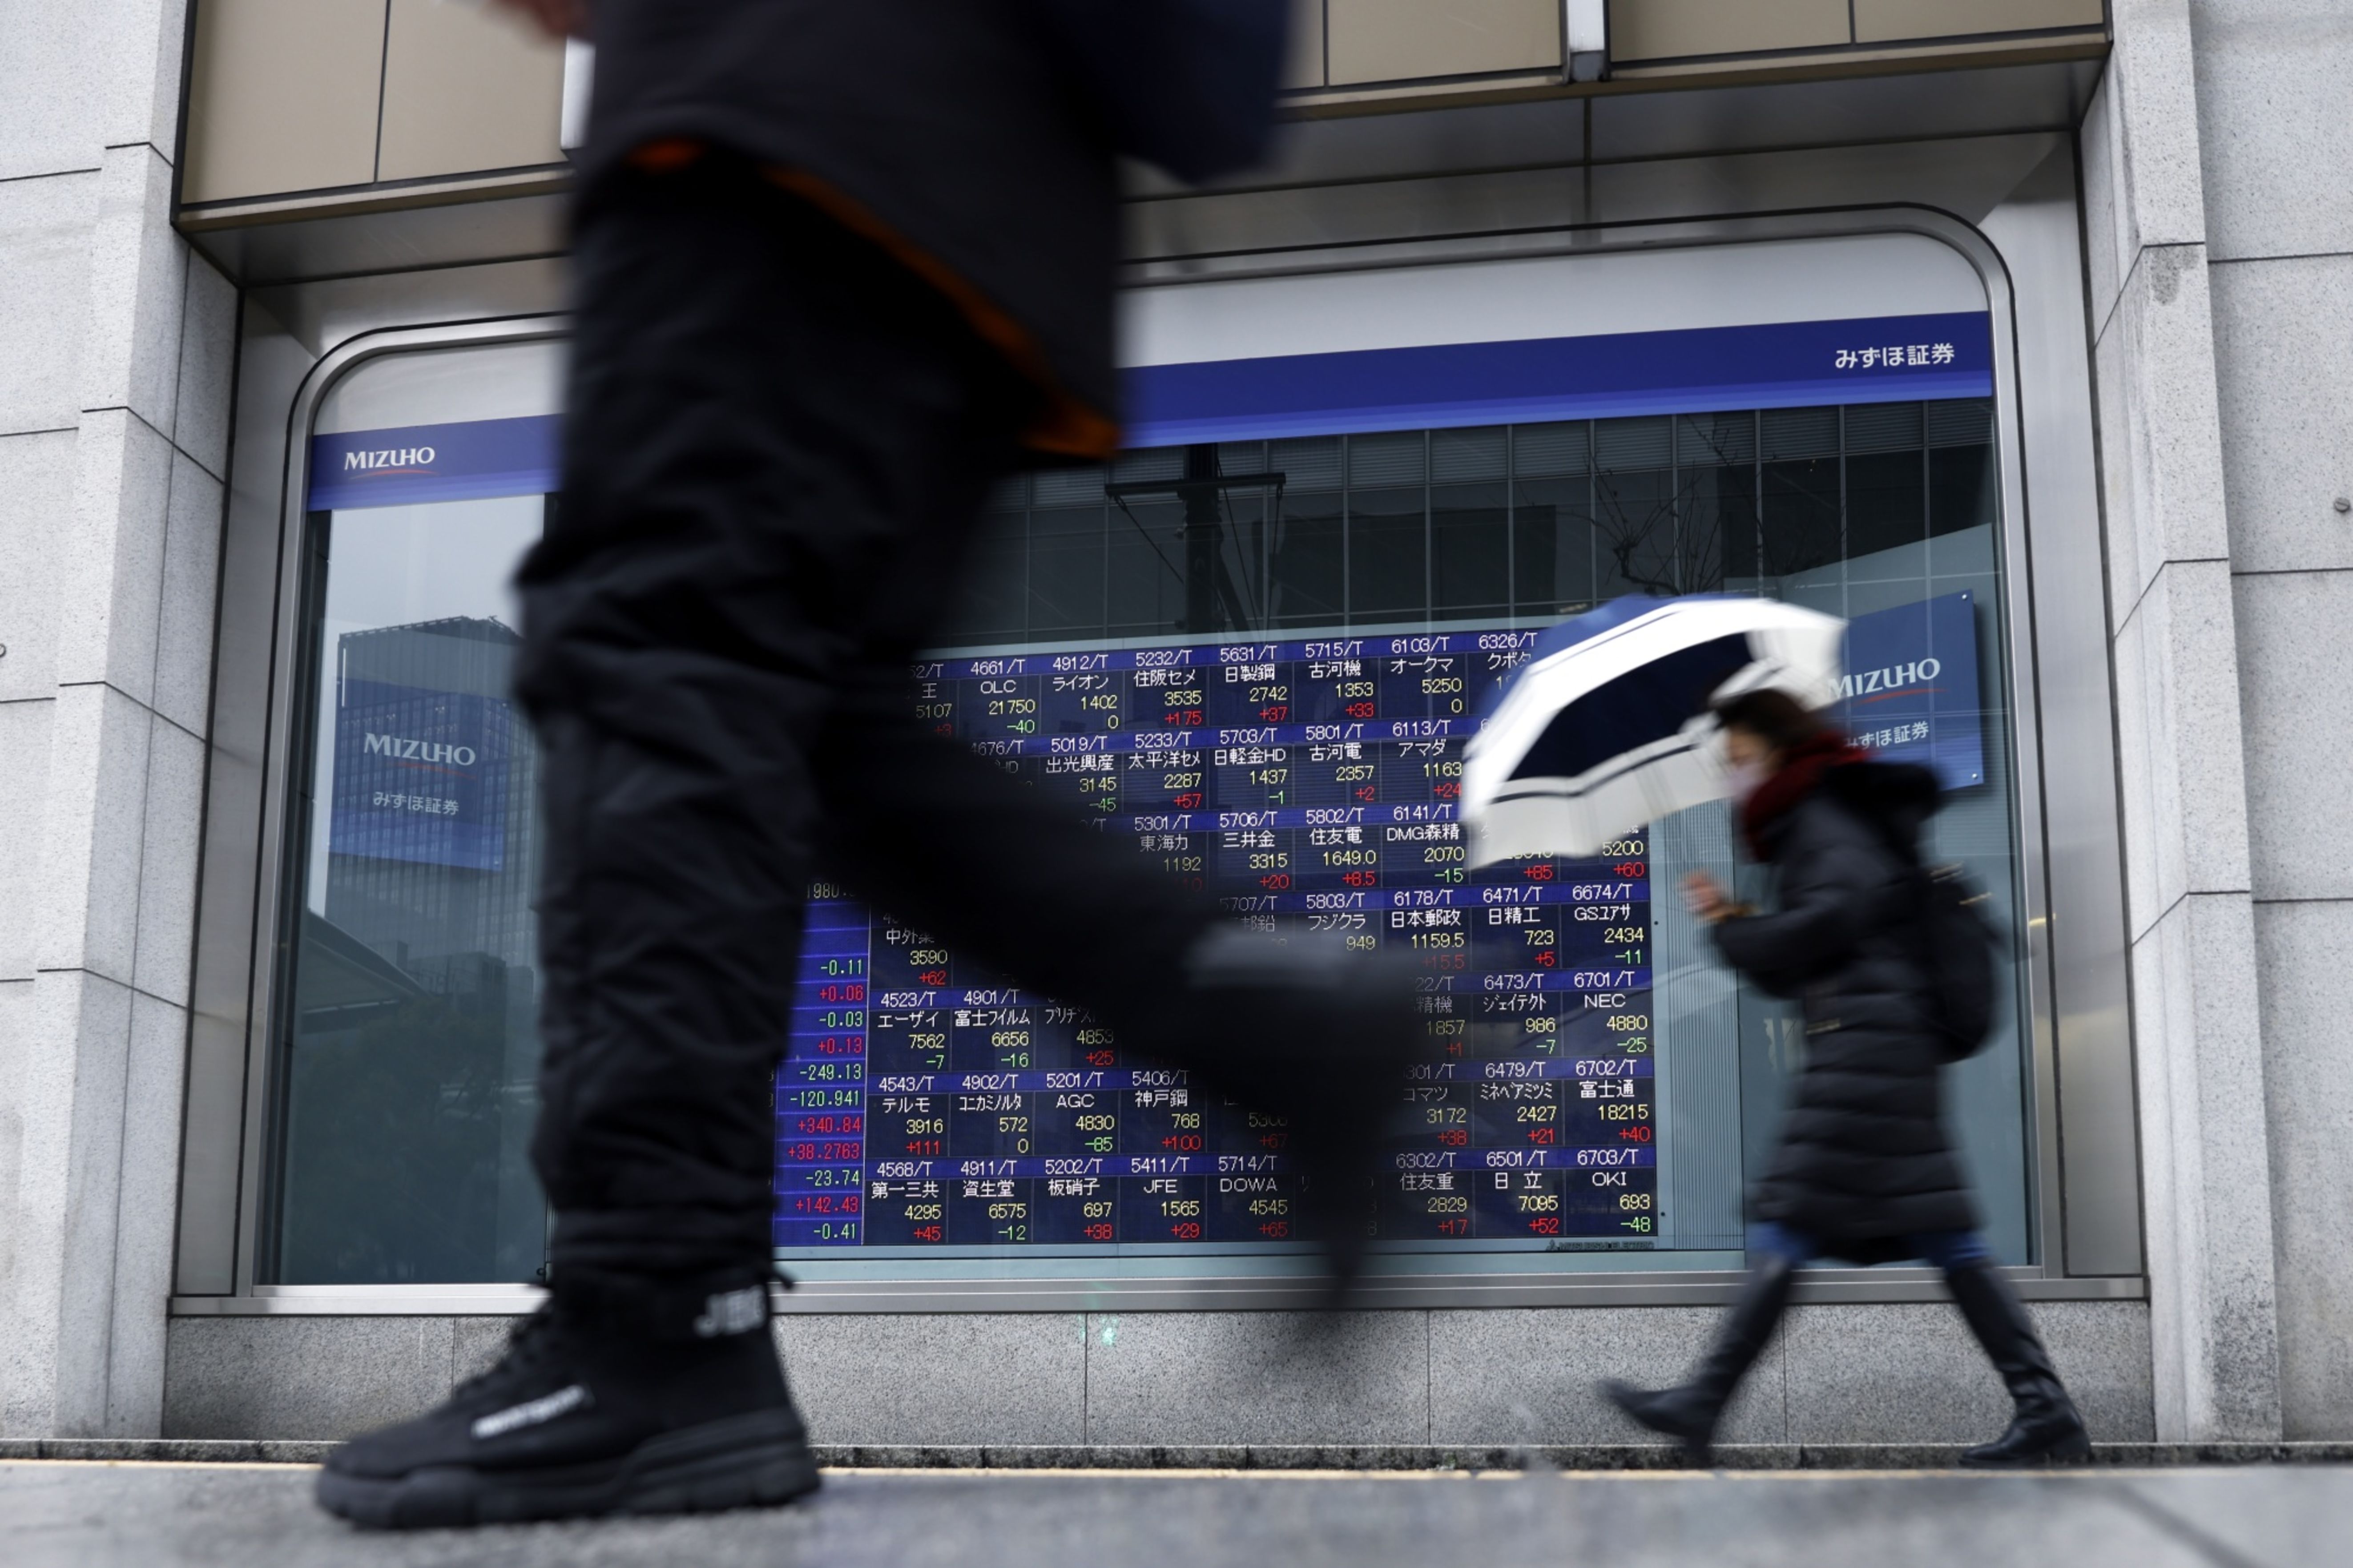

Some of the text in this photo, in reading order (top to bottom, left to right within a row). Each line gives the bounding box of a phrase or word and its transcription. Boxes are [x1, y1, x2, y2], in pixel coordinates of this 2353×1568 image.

[1835, 343, 1954, 368] みずほ証券
[344, 447, 435, 470] MIZUHO
[1391, 635, 1450, 653] 6103/T
[1479, 632, 1537, 649] 6326/T
[1135, 649, 1192, 666] 5232/T
[1221, 645, 1277, 662] 5631/T
[1305, 641, 1363, 658] 5715/T
[970, 658, 1026, 676] 4661/T
[1052, 654, 1108, 671] 4912/T
[1309, 660, 1362, 677] 古河機
[1390, 657, 1454, 674] オークマ
[1134, 668, 1197, 687] 住阪セメ
[1225, 663, 1275, 682] 日製鋼
[1827, 658, 1940, 699] MIZUHO
[980, 680, 1016, 693] OLC
[1052, 675, 1109, 692] ライオン
[1335, 682, 1374, 698] 1353
[1422, 677, 1462, 693] 5250
[1164, 689, 1202, 705] 3535
[1249, 686, 1287, 702] 2742
[989, 699, 1035, 715] 21750
[1081, 695, 1117, 710] 1402
[1346, 702, 1374, 718] +33
[1165, 709, 1202, 726] +175
[1259, 706, 1287, 722] +37
[1220, 728, 1278, 744] 5703/T
[1305, 724, 1364, 740] 5801/T
[1392, 719, 1450, 737] 6113/T
[1051, 735, 1108, 752] 5019/T
[1135, 731, 1193, 748] 5233/T
[363, 733, 476, 766] MIZUHO
[1309, 742, 1362, 760] 古河電
[1398, 740, 1446, 757] アマダ
[1046, 754, 1114, 774] 出光興産
[1214, 748, 1286, 766] 日軽金HD
[1249, 769, 1287, 785] 1437
[1335, 765, 1375, 781] 2357
[1423, 762, 1462, 777] 1163
[1080, 776, 1117, 792] 3145
[1164, 772, 1202, 788] 2287
[373, 791, 459, 815] みずほ証券
[1174, 793, 1202, 808] +57
[1220, 810, 1278, 827] 5706/T
[1306, 807, 1364, 824] 5802/T
[1394, 803, 1452, 821] 6141/T
[1134, 814, 1192, 831] 5301/T
[1223, 830, 1275, 848] 三井金
[1309, 826, 1362, 844] 住友電
[1386, 823, 1459, 842] DMG森精
[1424, 846, 1464, 863] 2070
[1603, 841, 1643, 855] 5200
[1249, 852, 1288, 868] 3315
[1322, 849, 1376, 866] 1649.0
[1434, 868, 1463, 883] -15
[1524, 865, 1553, 880] +85
[1614, 862, 1644, 877] +60
[1259, 874, 1289, 890] +20
[1342, 871, 1375, 887] +8.5
[1394, 888, 1453, 907] 6178/T
[1483, 886, 1543, 903] 6471/T
[1572, 884, 1632, 901] 6674/T
[1306, 892, 1364, 910] 5803/T
[1391, 908, 1462, 928] 日本郵政
[1489, 907, 1540, 924] 日精工
[1574, 903, 1630, 922] GSユアサ
[1308, 912, 1366, 931] フジクラ
[1411, 933, 1464, 949] 1159.5
[1524, 930, 1554, 945] 723
[1604, 927, 1644, 943] 2434
[910, 950, 947, 965] 3590
[1615, 949, 1640, 964] -11
[821, 960, 862, 975] -0.11
[919, 971, 946, 985] +62
[1484, 974, 1544, 989] 6473/T
[1574, 971, 1635, 988] 6701/T
[820, 986, 863, 1001] +0.06
[880, 991, 937, 1008] 4523/T
[964, 989, 1020, 1005] 4901/T
[1584, 994, 1626, 1007] NEC
[1483, 994, 1546, 1012] ジェイテクト
[819, 1012, 863, 1027] -0.03
[878, 1011, 940, 1028] エーザイ
[955, 1009, 1030, 1025] 富士フイルム
[1526, 1018, 1555, 1032] 986
[1607, 1016, 1647, 1031] 4880
[819, 1038, 862, 1053] +0.13
[909, 1034, 945, 1048] 7562
[991, 1032, 1028, 1046] 6656
[1617, 1038, 1646, 1052] -25
[1000, 1053, 1028, 1068] -16
[1576, 1060, 1637, 1075] 6702/T
[800, 1064, 861, 1080] -249.13
[1486, 1063, 1545, 1078] 6479/T
[878, 1076, 935, 1091] 4543/T
[962, 1073, 1019, 1090] 4902/T
[1046, 1072, 1104, 1088] 5201/T
[1480, 1082, 1553, 1100] ミネベアミツミ
[1579, 1081, 1635, 1098] 富士通
[790, 1091, 859, 1107] -120.941
[882, 1097, 930, 1113] テルモ
[960, 1094, 1022, 1111] コニカミノルタ
[1056, 1094, 1095, 1108] AGC
[1135, 1089, 1187, 1107] 神戸鋼
[1517, 1106, 1556, 1121] 2427
[1598, 1105, 1648, 1120] 18215
[798, 1117, 860, 1133] +340.84
[907, 1119, 943, 1133] 3916
[1000, 1118, 1028, 1132] 572
[1076, 1115, 1114, 1130] 4830
[1171, 1113, 1199, 1129] 768
[1162, 1135, 1201, 1150] +100
[1528, 1129, 1554, 1144] +21
[1619, 1127, 1650, 1142] +40
[789, 1144, 860, 1160] +38.2763
[907, 1141, 940, 1155] +111
[1085, 1137, 1112, 1152] -85
[1131, 1157, 1190, 1173] 5411/T
[1396, 1152, 1456, 1168] 6302/T
[1487, 1151, 1547, 1166] 6501/T
[1577, 1149, 1638, 1165] 6703/T
[877, 1161, 933, 1177] 4568/T
[960, 1160, 1017, 1176] 4911/T
[1045, 1158, 1103, 1174] 5202/T
[806, 1171, 860, 1186] -23.74
[1144, 1179, 1178, 1193] JFE
[1400, 1173, 1455, 1191] 住友重
[1592, 1173, 1625, 1185] OKI
[871, 1182, 939, 1199] 第一三共
[963, 1180, 1015, 1197] 資生堂
[1048, 1178, 1100, 1197] 板硝子
[796, 1197, 858, 1213] +142.43
[1084, 1202, 1112, 1217] 697
[1161, 1201, 1199, 1217] 1565
[1519, 1196, 1558, 1211] 7095
[1620, 1195, 1650, 1210] 693
[905, 1205, 941, 1219] 4295
[989, 1204, 1026, 1218] 6575
[814, 1224, 855, 1239] -0.41
[914, 1226, 941, 1241] +45
[998, 1225, 1025, 1240] -12
[1084, 1224, 1112, 1239] +38
[1171, 1223, 1199, 1238] +29
[1529, 1218, 1558, 1233] +52
[1620, 1218, 1650, 1233] -48
